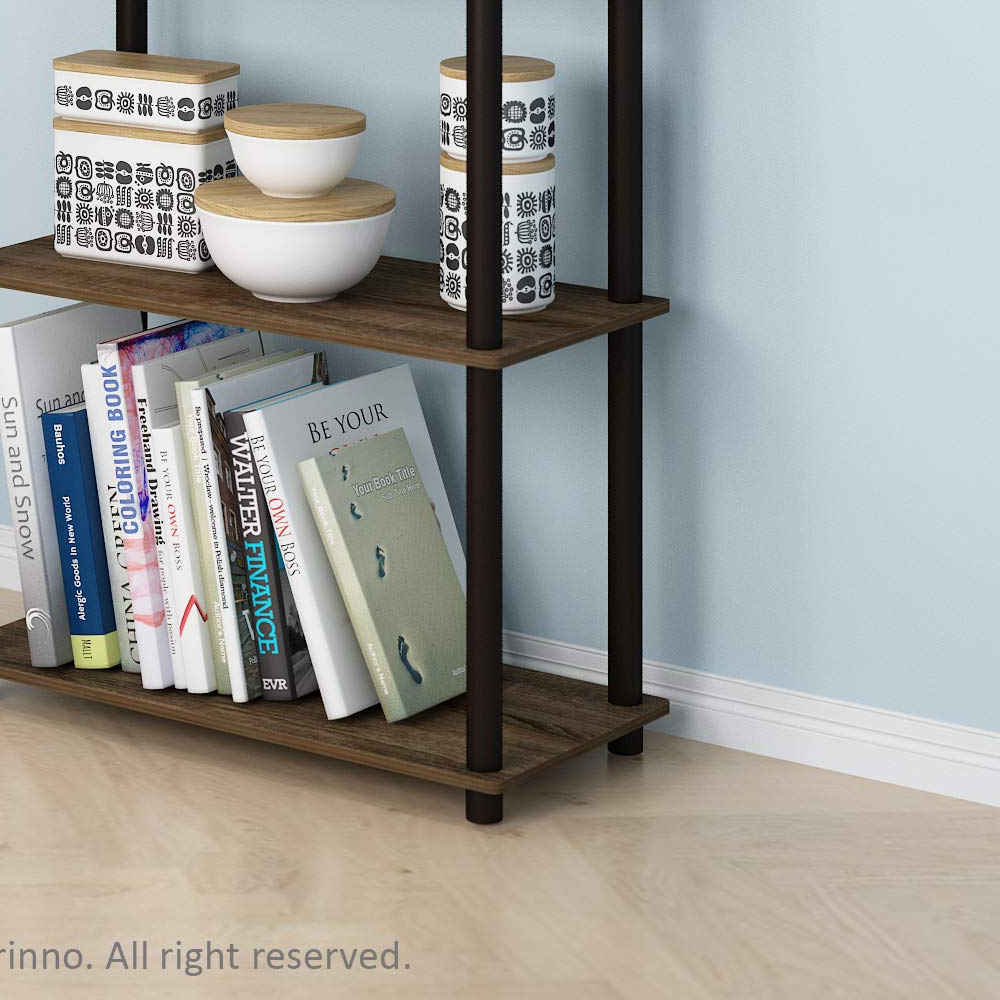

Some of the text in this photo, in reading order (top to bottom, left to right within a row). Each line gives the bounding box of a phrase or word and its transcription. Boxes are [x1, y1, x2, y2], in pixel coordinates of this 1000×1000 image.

[308, 420, 332, 444] BE
[334, 402, 389, 434] YOUR
[100, 364, 139, 535] COLORING BOOK
[1, 396, 34, 561] Sun and Snow
[137, 398, 157, 473] Freehand
[148, 479, 166, 546] Drawing
[229, 431, 262, 538] WALTER
[352, 466, 416, 497] Your Book Title
[61, 496, 73, 522] World
[159, 451, 183, 571] BE YOUR OWN BOSS
[209, 504, 218, 540] welcome
[250, 435, 301, 577] BE YOUR OWN BOSS
[67, 523, 76, 544] New
[70, 558, 82, 588] Goods
[215, 550, 224, 573] Polish
[73, 589, 87, 621] Alergic
[219, 574, 229, 610] diamond
[244, 540, 279, 655] FINANCE
[262, 678, 288, 690] EVR
